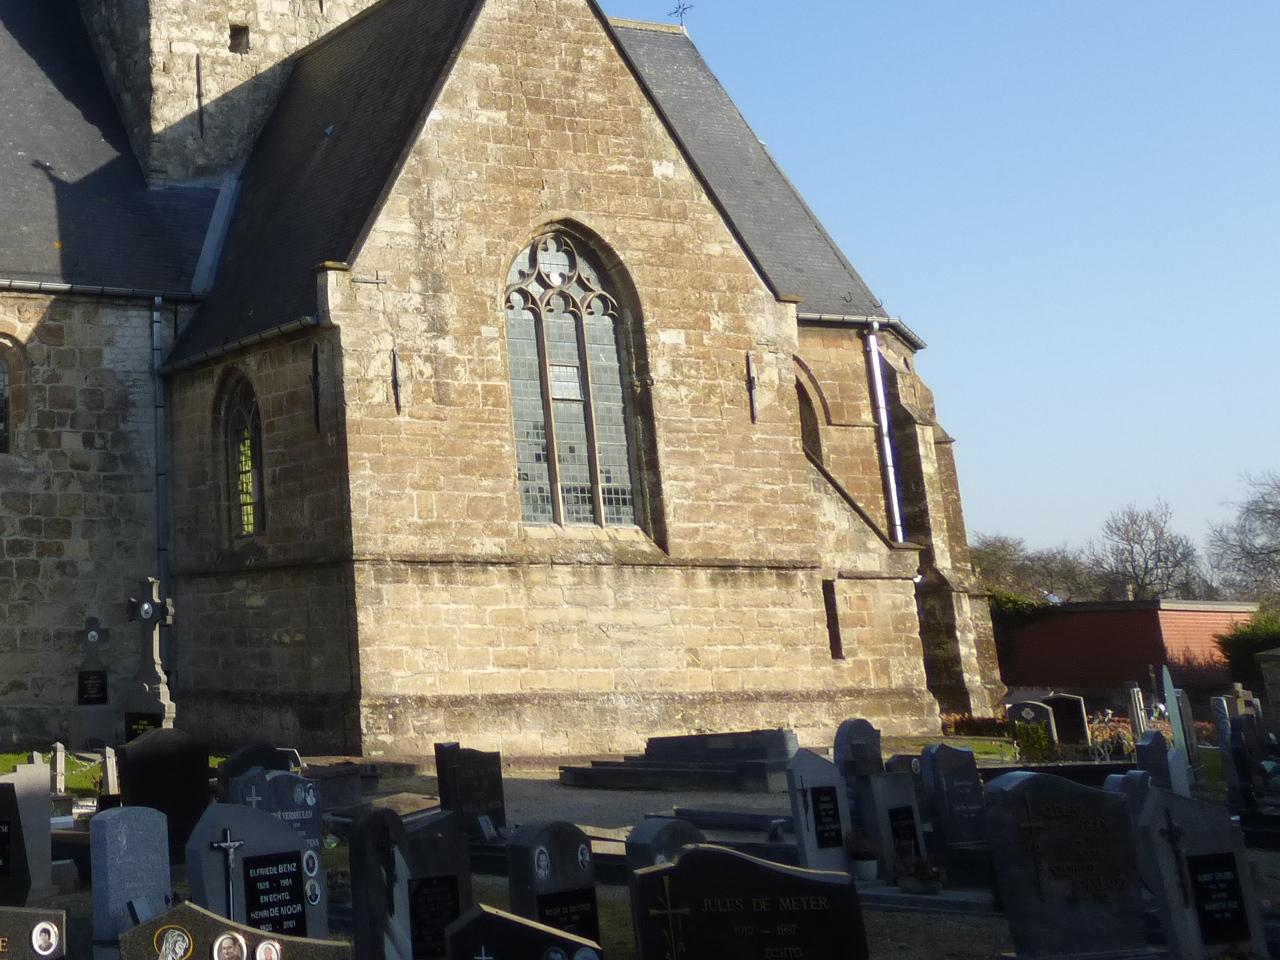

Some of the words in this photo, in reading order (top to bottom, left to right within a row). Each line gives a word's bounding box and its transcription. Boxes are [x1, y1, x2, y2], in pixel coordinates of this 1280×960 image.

[249, 865, 278, 878] ELFRIEDE
[278, 862, 297, 875] BENZ
[270, 906, 279, 917] DE
[280, 904, 303, 916] MOOR
[702, 895, 744, 912] JULES
[751, 896, 770, 912] DE
[778, 895, 830, 912] MEYER
